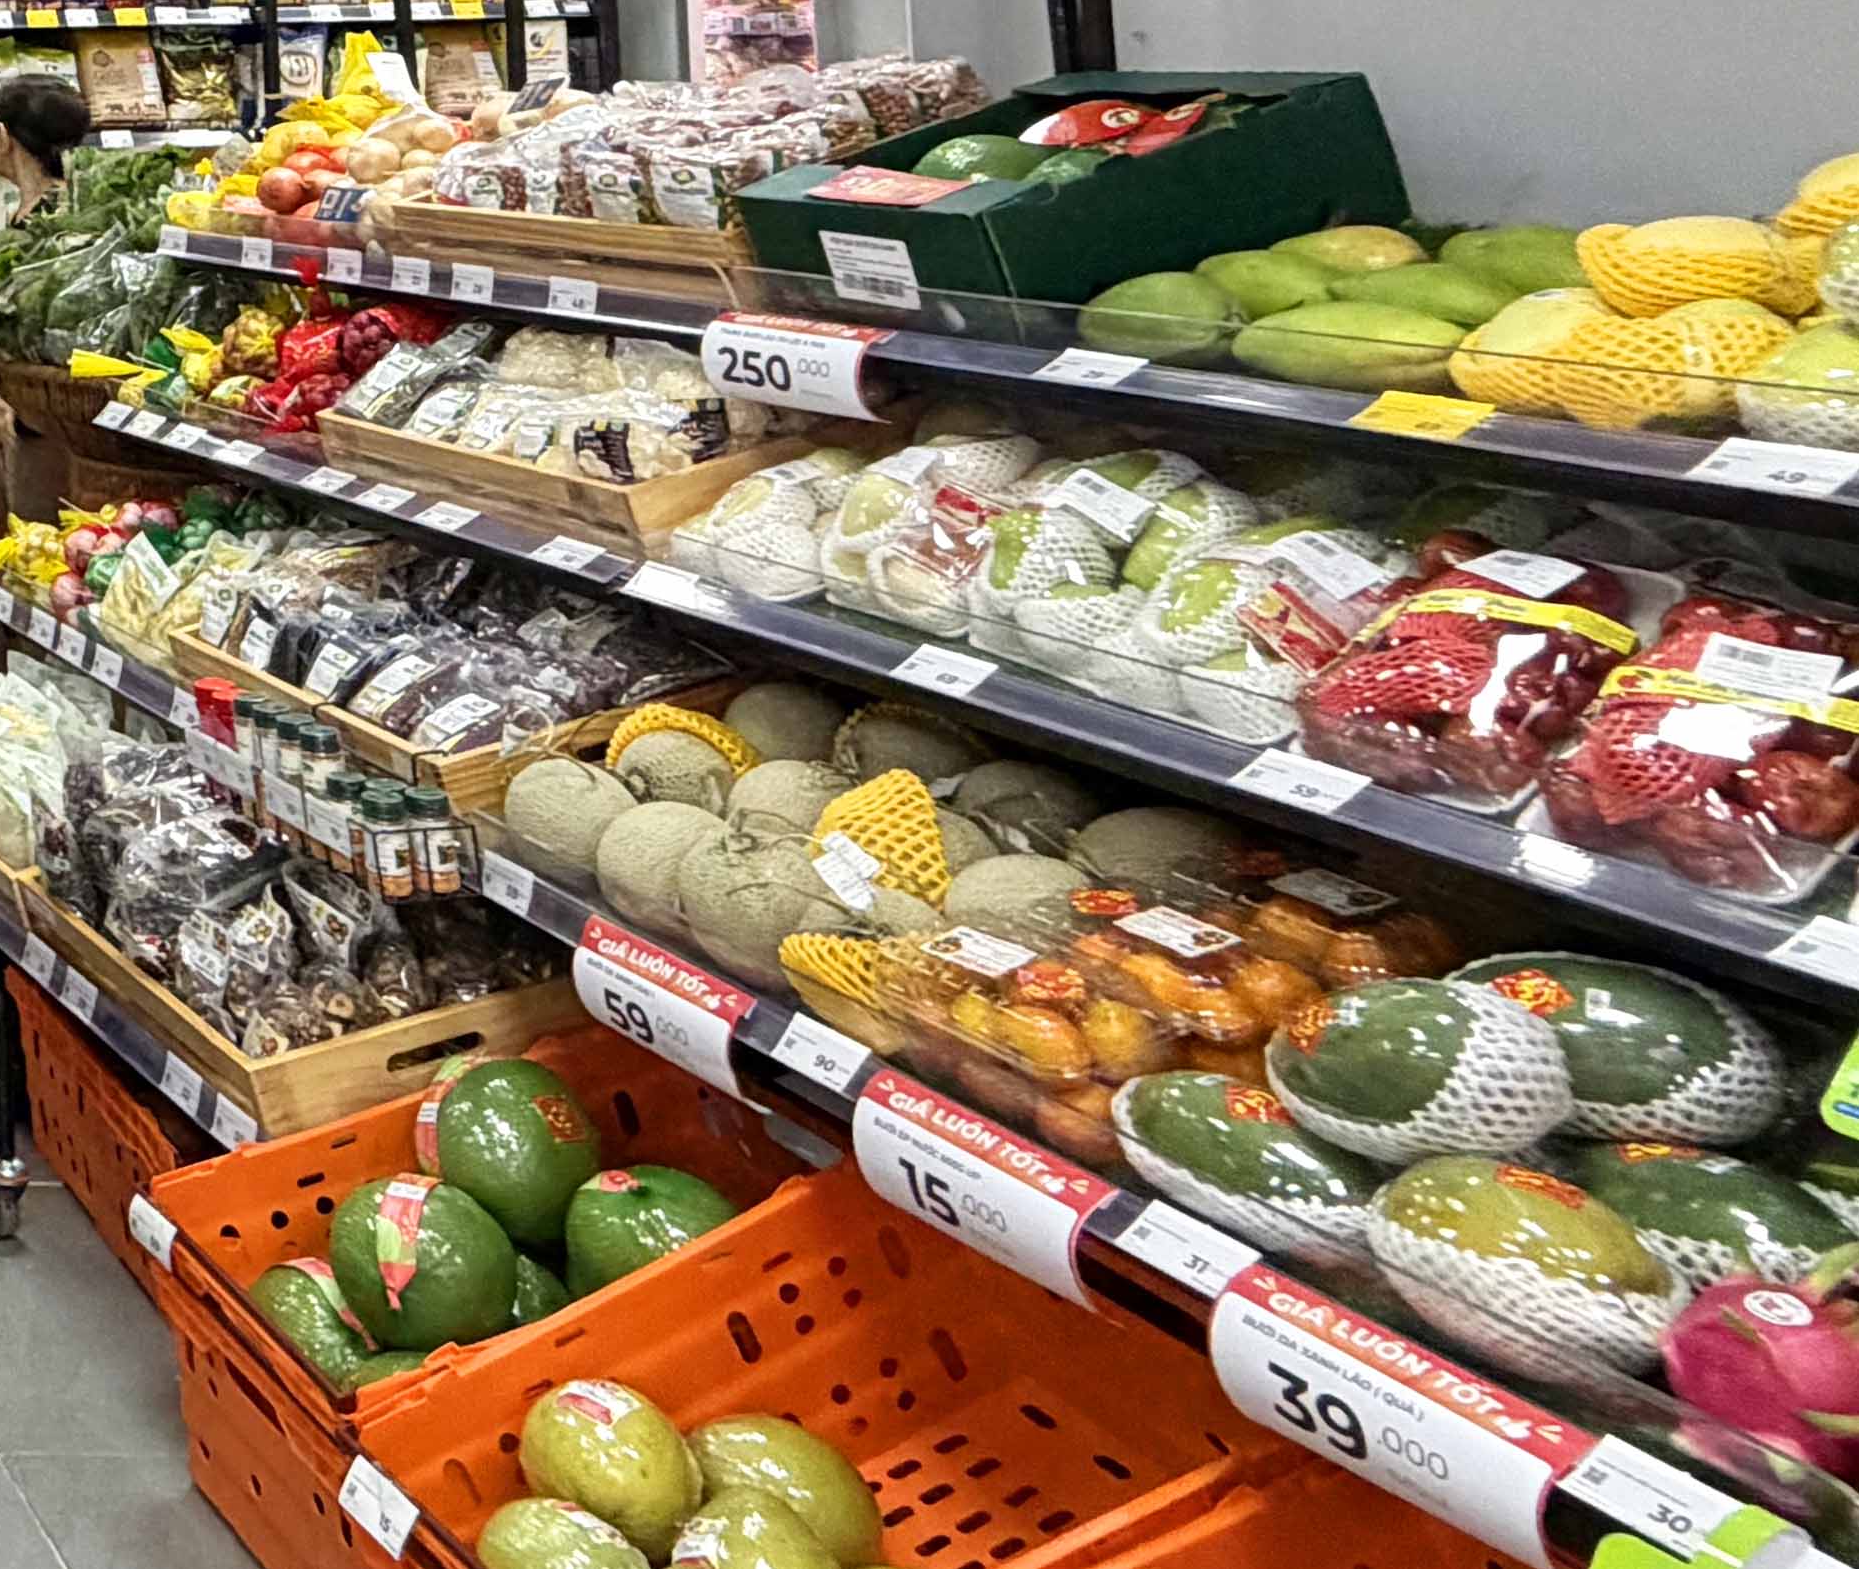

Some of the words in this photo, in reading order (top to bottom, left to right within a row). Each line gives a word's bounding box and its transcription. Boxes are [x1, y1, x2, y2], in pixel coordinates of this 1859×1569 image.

[718, 346, 791, 392] 250
[604, 988, 654, 1043] 59
[813, 1054, 835, 1072] 90
[999, 1142, 1049, 1175] TỐT
[899, 1156, 960, 1227] 15
[1268, 1291, 1327, 1329] GIÁ
[1329, 1317, 1433, 1377] LUÔN
[1429, 1369, 1505, 1415] TỐT
[1276, 1333, 1299, 1351] DA
[1268, 1359, 1369, 1460] 39
[1647, 1504, 1692, 1534] 30
